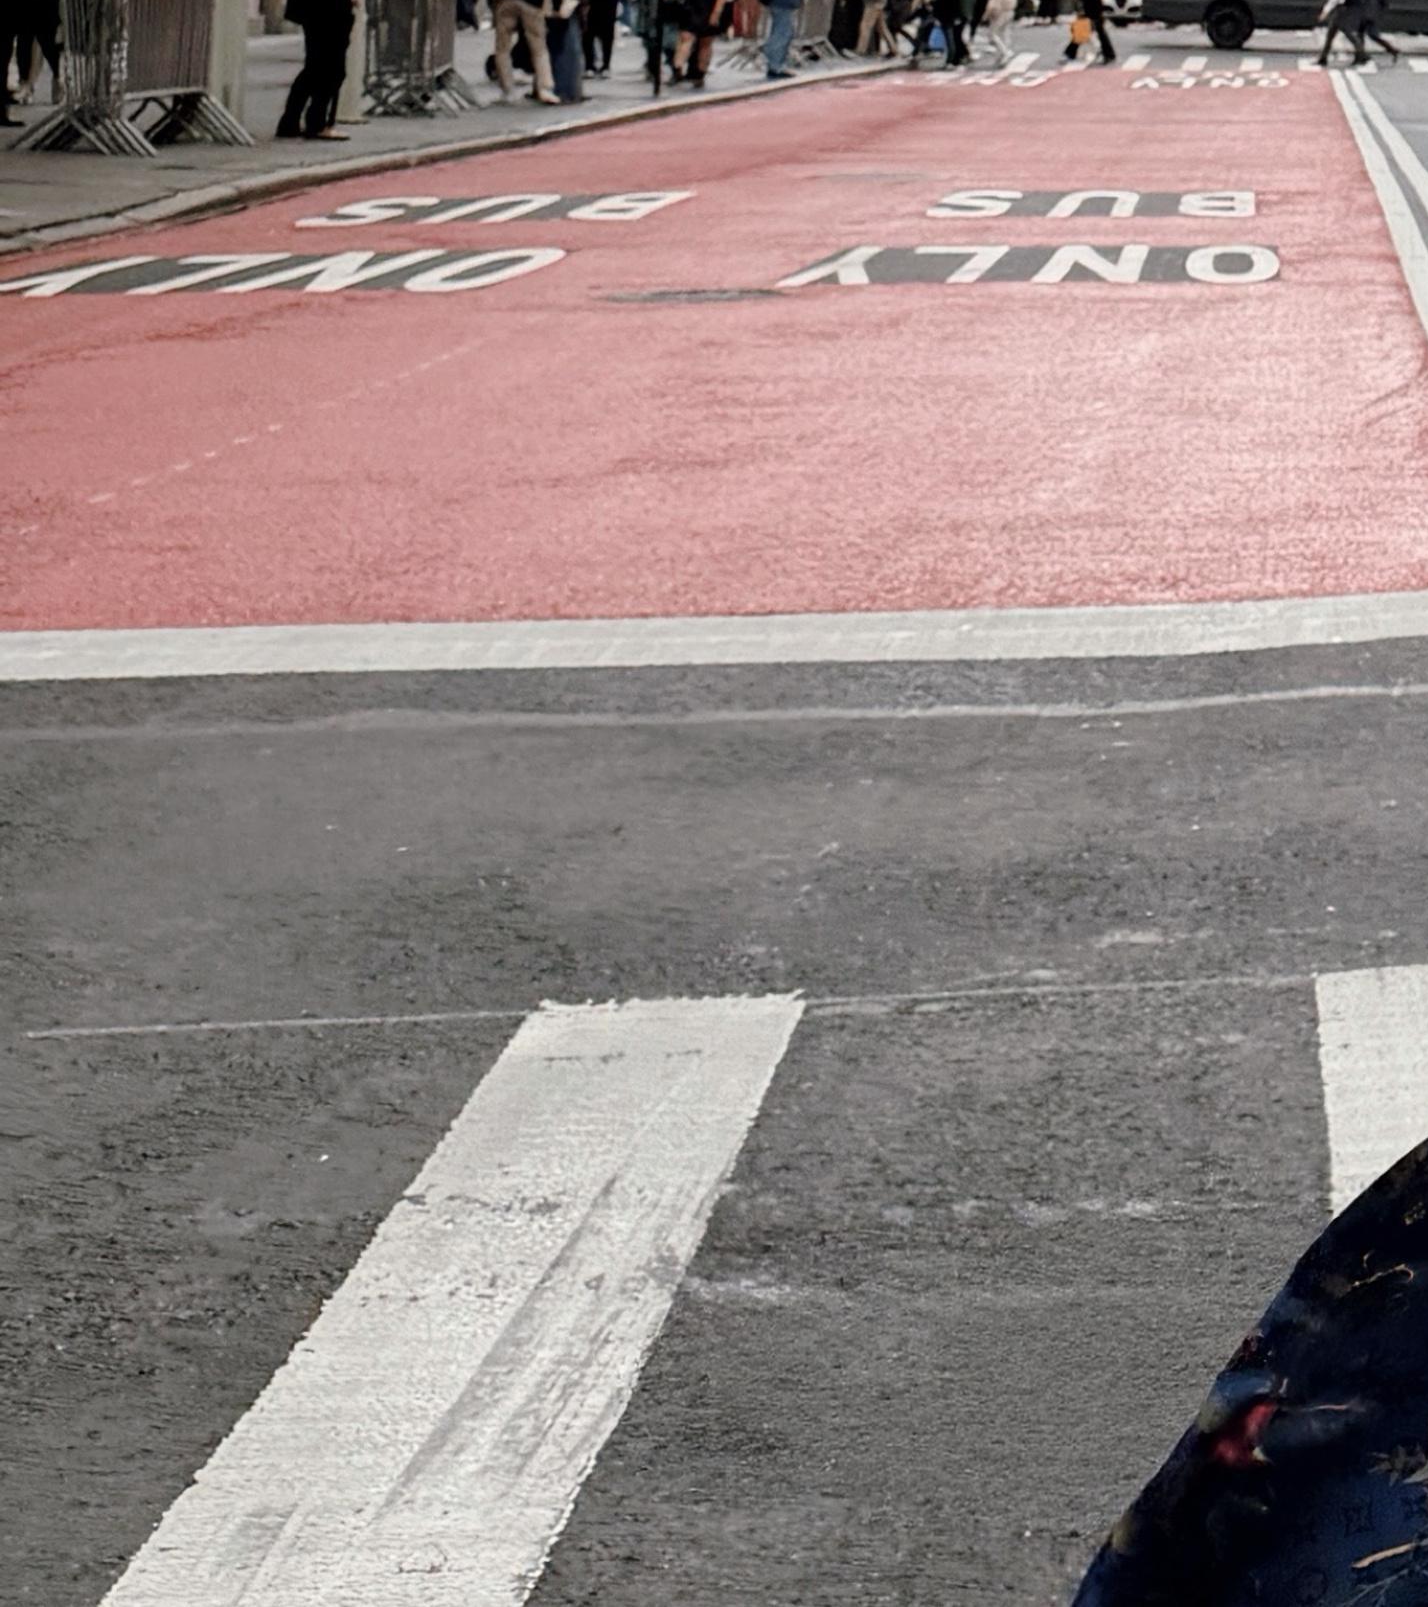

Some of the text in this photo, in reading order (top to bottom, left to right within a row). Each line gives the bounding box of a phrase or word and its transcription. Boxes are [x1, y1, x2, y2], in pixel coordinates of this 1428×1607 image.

[295, 191, 697, 227] BUS
[926, 190, 1257, 219] BUS
[0, 247, 567, 299] ONLY
[774, 244, 1281, 288] ONLY
